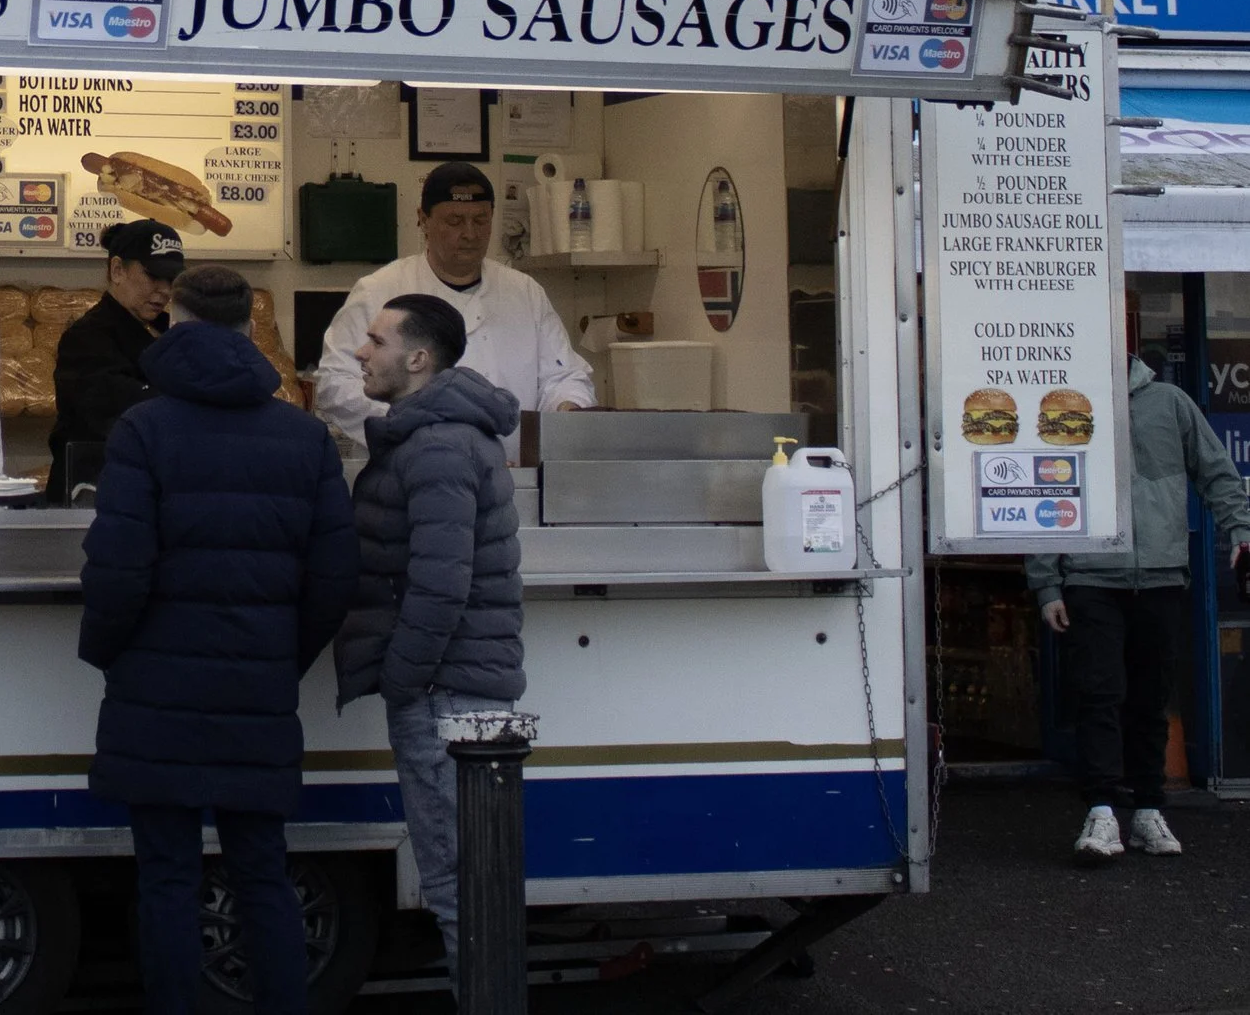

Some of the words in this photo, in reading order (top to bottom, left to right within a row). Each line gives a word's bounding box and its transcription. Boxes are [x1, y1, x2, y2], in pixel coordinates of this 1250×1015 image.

[49, 11, 93, 29] VISA
[108, 16, 151, 28] Maestro
[872, 24, 892, 33] CARD
[893, 25, 930, 34] PAYMENTS
[930, 26, 965, 35] WELCOME
[871, 45, 909, 61] VISA
[922, 49, 961, 59] Maestro
[1026, 41, 1089, 68] ALITY
[19, 76, 79, 90] BOTTLED
[83, 79, 133, 92] DRINKS
[19, 95, 48, 113] HOT
[53, 96, 103, 114] DRINKS
[236, 101, 279, 116] £3.00
[19, 117, 44, 135] SPA
[47, 118, 92, 136] WATER
[234, 124, 277, 139] £3.00
[995, 113, 1066, 128] POUNDER
[225, 147, 261, 156] LARGE
[996, 137, 1067, 152] POUNDER
[205, 158, 282, 170] FRANKFURTER
[971, 153, 1010, 166] WITH
[1014, 155, 1071, 167] CHEESE
[206, 172, 242, 181] DOUBLE
[245, 173, 280, 182] CHEESE
[997, 175, 1068, 190] POUNDER
[221, 186, 264, 201] £8.00
[963, 192, 1022, 205] DOUBLE
[1026, 193, 1083, 205] CHEESE
[79, 197, 117, 206] JUMBO
[73, 209, 123, 219] SAUSAGE
[942, 213, 992, 229] JUMBO
[996, 213, 1062, 229] SAUSAGE
[1066, 214, 1103, 229] ROLL
[96, 222, 115, 230] BAC
[75, 232, 100, 247] £9.
[943, 237, 992, 252] LARGE
[996, 237, 1103, 252] FRANKFURTER
[950, 261, 992, 276] SPICY
[996, 261, 1097, 276] BEANBURGER
[974, 279, 1013, 290] WITH
[1017, 279, 1075, 291] CHEESE
[974, 322, 1015, 338] COLD
[1019, 323, 1075, 338] DRINKS
[981, 346, 1012, 361] HOT
[1016, 346, 1072, 361] DRINKS
[986, 369, 1015, 385] SPA
[1017, 370, 1068, 385] WATER
[1042, 488, 1074, 496] WELCOME
[990, 507, 1027, 522] VISA
[1038, 508, 1074, 518] Maestro
